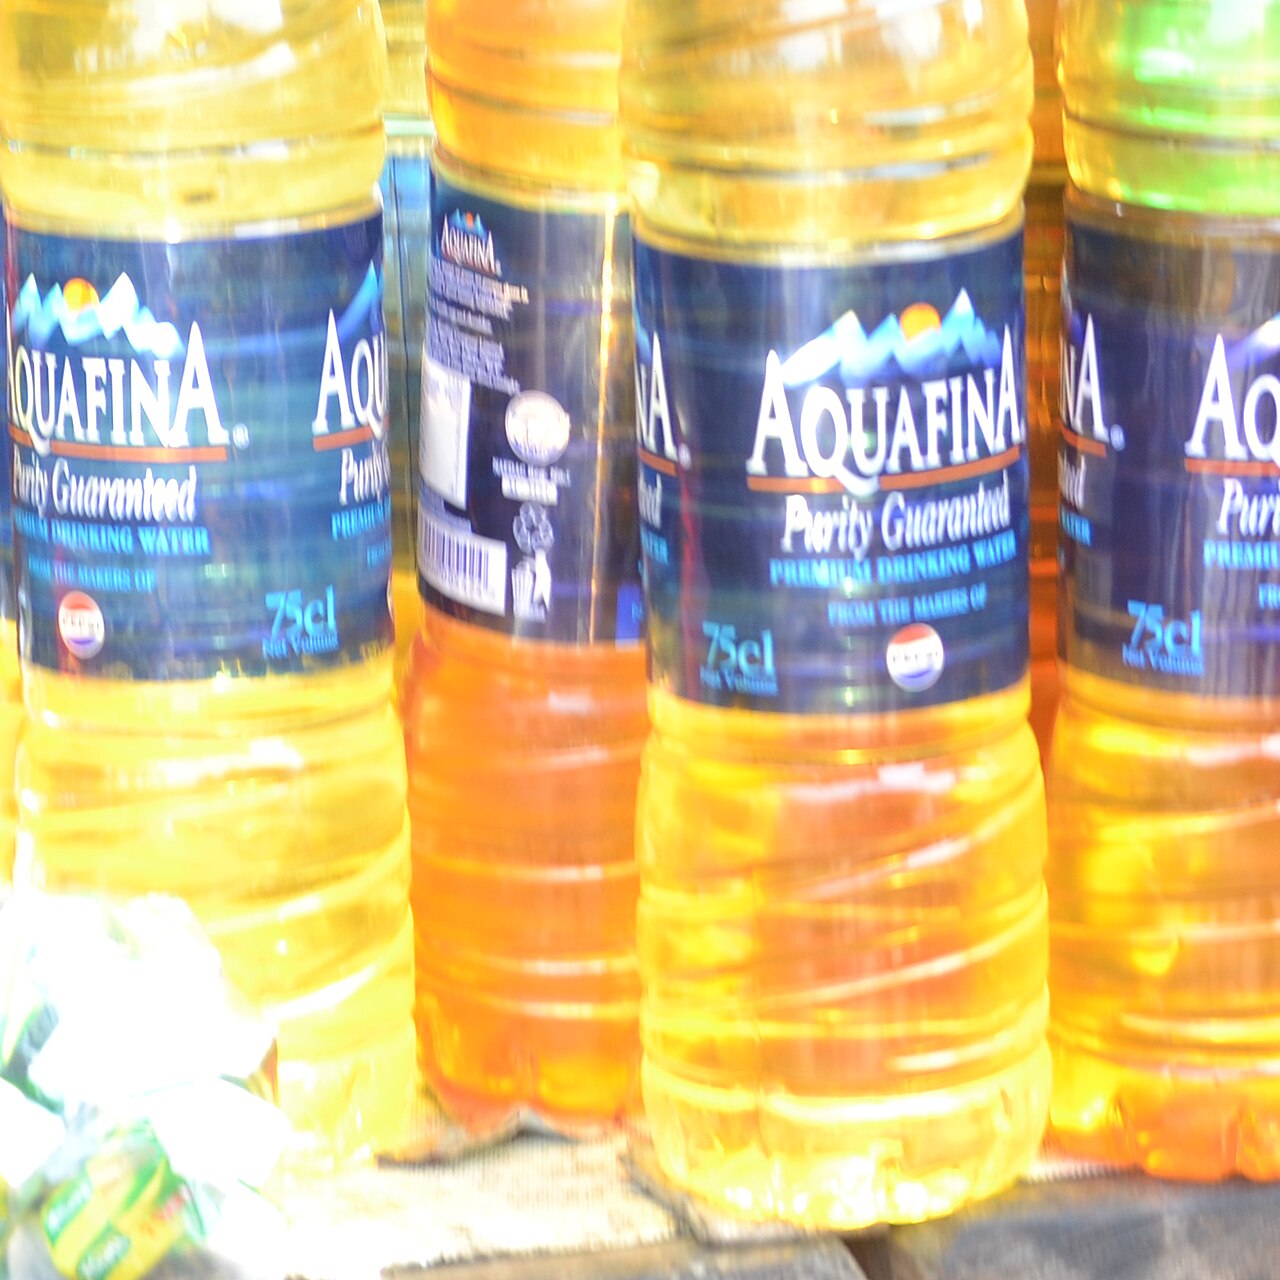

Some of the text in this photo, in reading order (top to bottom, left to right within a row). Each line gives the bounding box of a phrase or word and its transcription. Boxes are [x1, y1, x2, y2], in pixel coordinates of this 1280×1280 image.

[441, 214, 495, 276] AQUAFINA
[746, 323, 1020, 496] AQUAFINA
[51, 457, 198, 523] Guaranteed
[780, 470, 1011, 563] Purity Guaranteed
[51, 518, 134, 555] DRINKING
[137, 525, 212, 556] WATER
[769, 557, 872, 589] PREMIUM
[876, 543, 971, 585] DRINKING
[265, 584, 337, 638] 75cl
[1126, 600, 1203, 657] 75cl
[702, 621, 776, 681] 75cl
